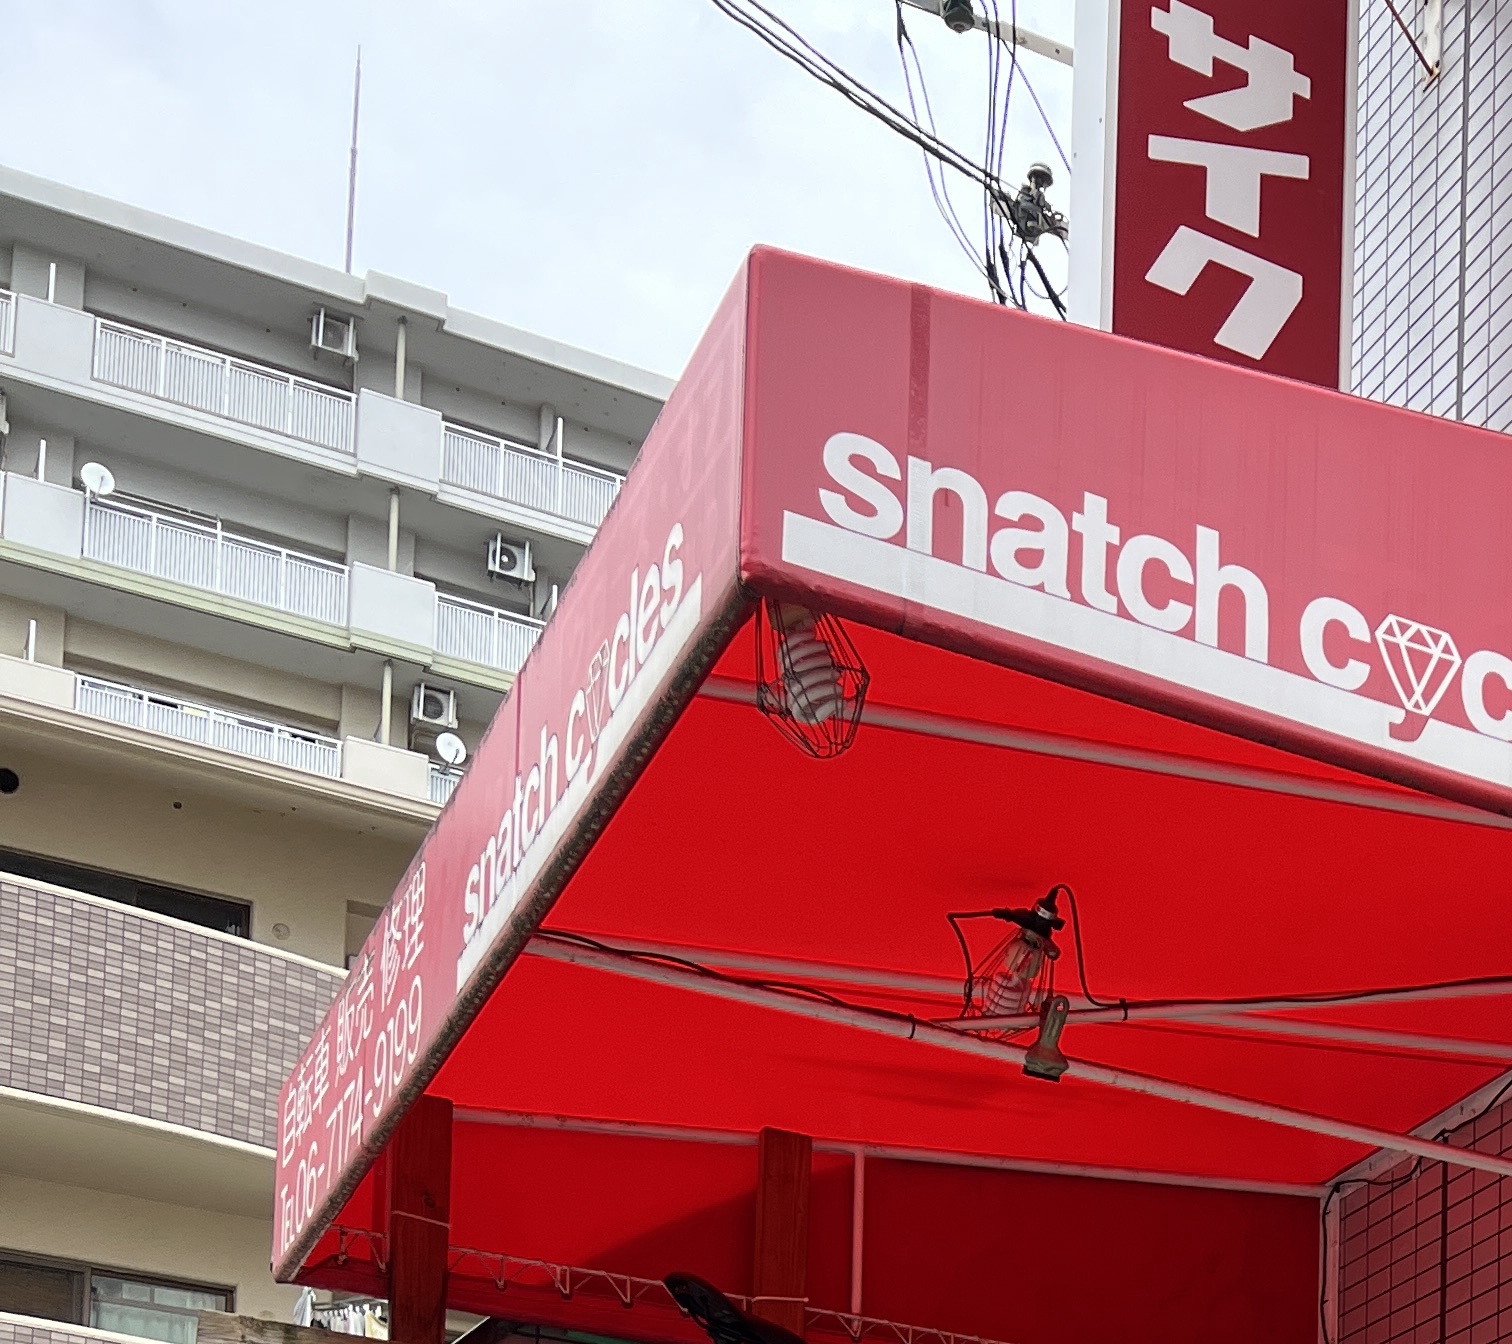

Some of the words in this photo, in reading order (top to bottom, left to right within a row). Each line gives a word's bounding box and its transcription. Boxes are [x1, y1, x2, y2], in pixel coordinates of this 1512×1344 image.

[818, 431, 1270, 665] snatch
[463, 721, 559, 945] snatch
[281, 1024, 332, 1168] 自転車
[335, 948, 375, 1081] 販売
[379, 860, 427, 1014] 修理
